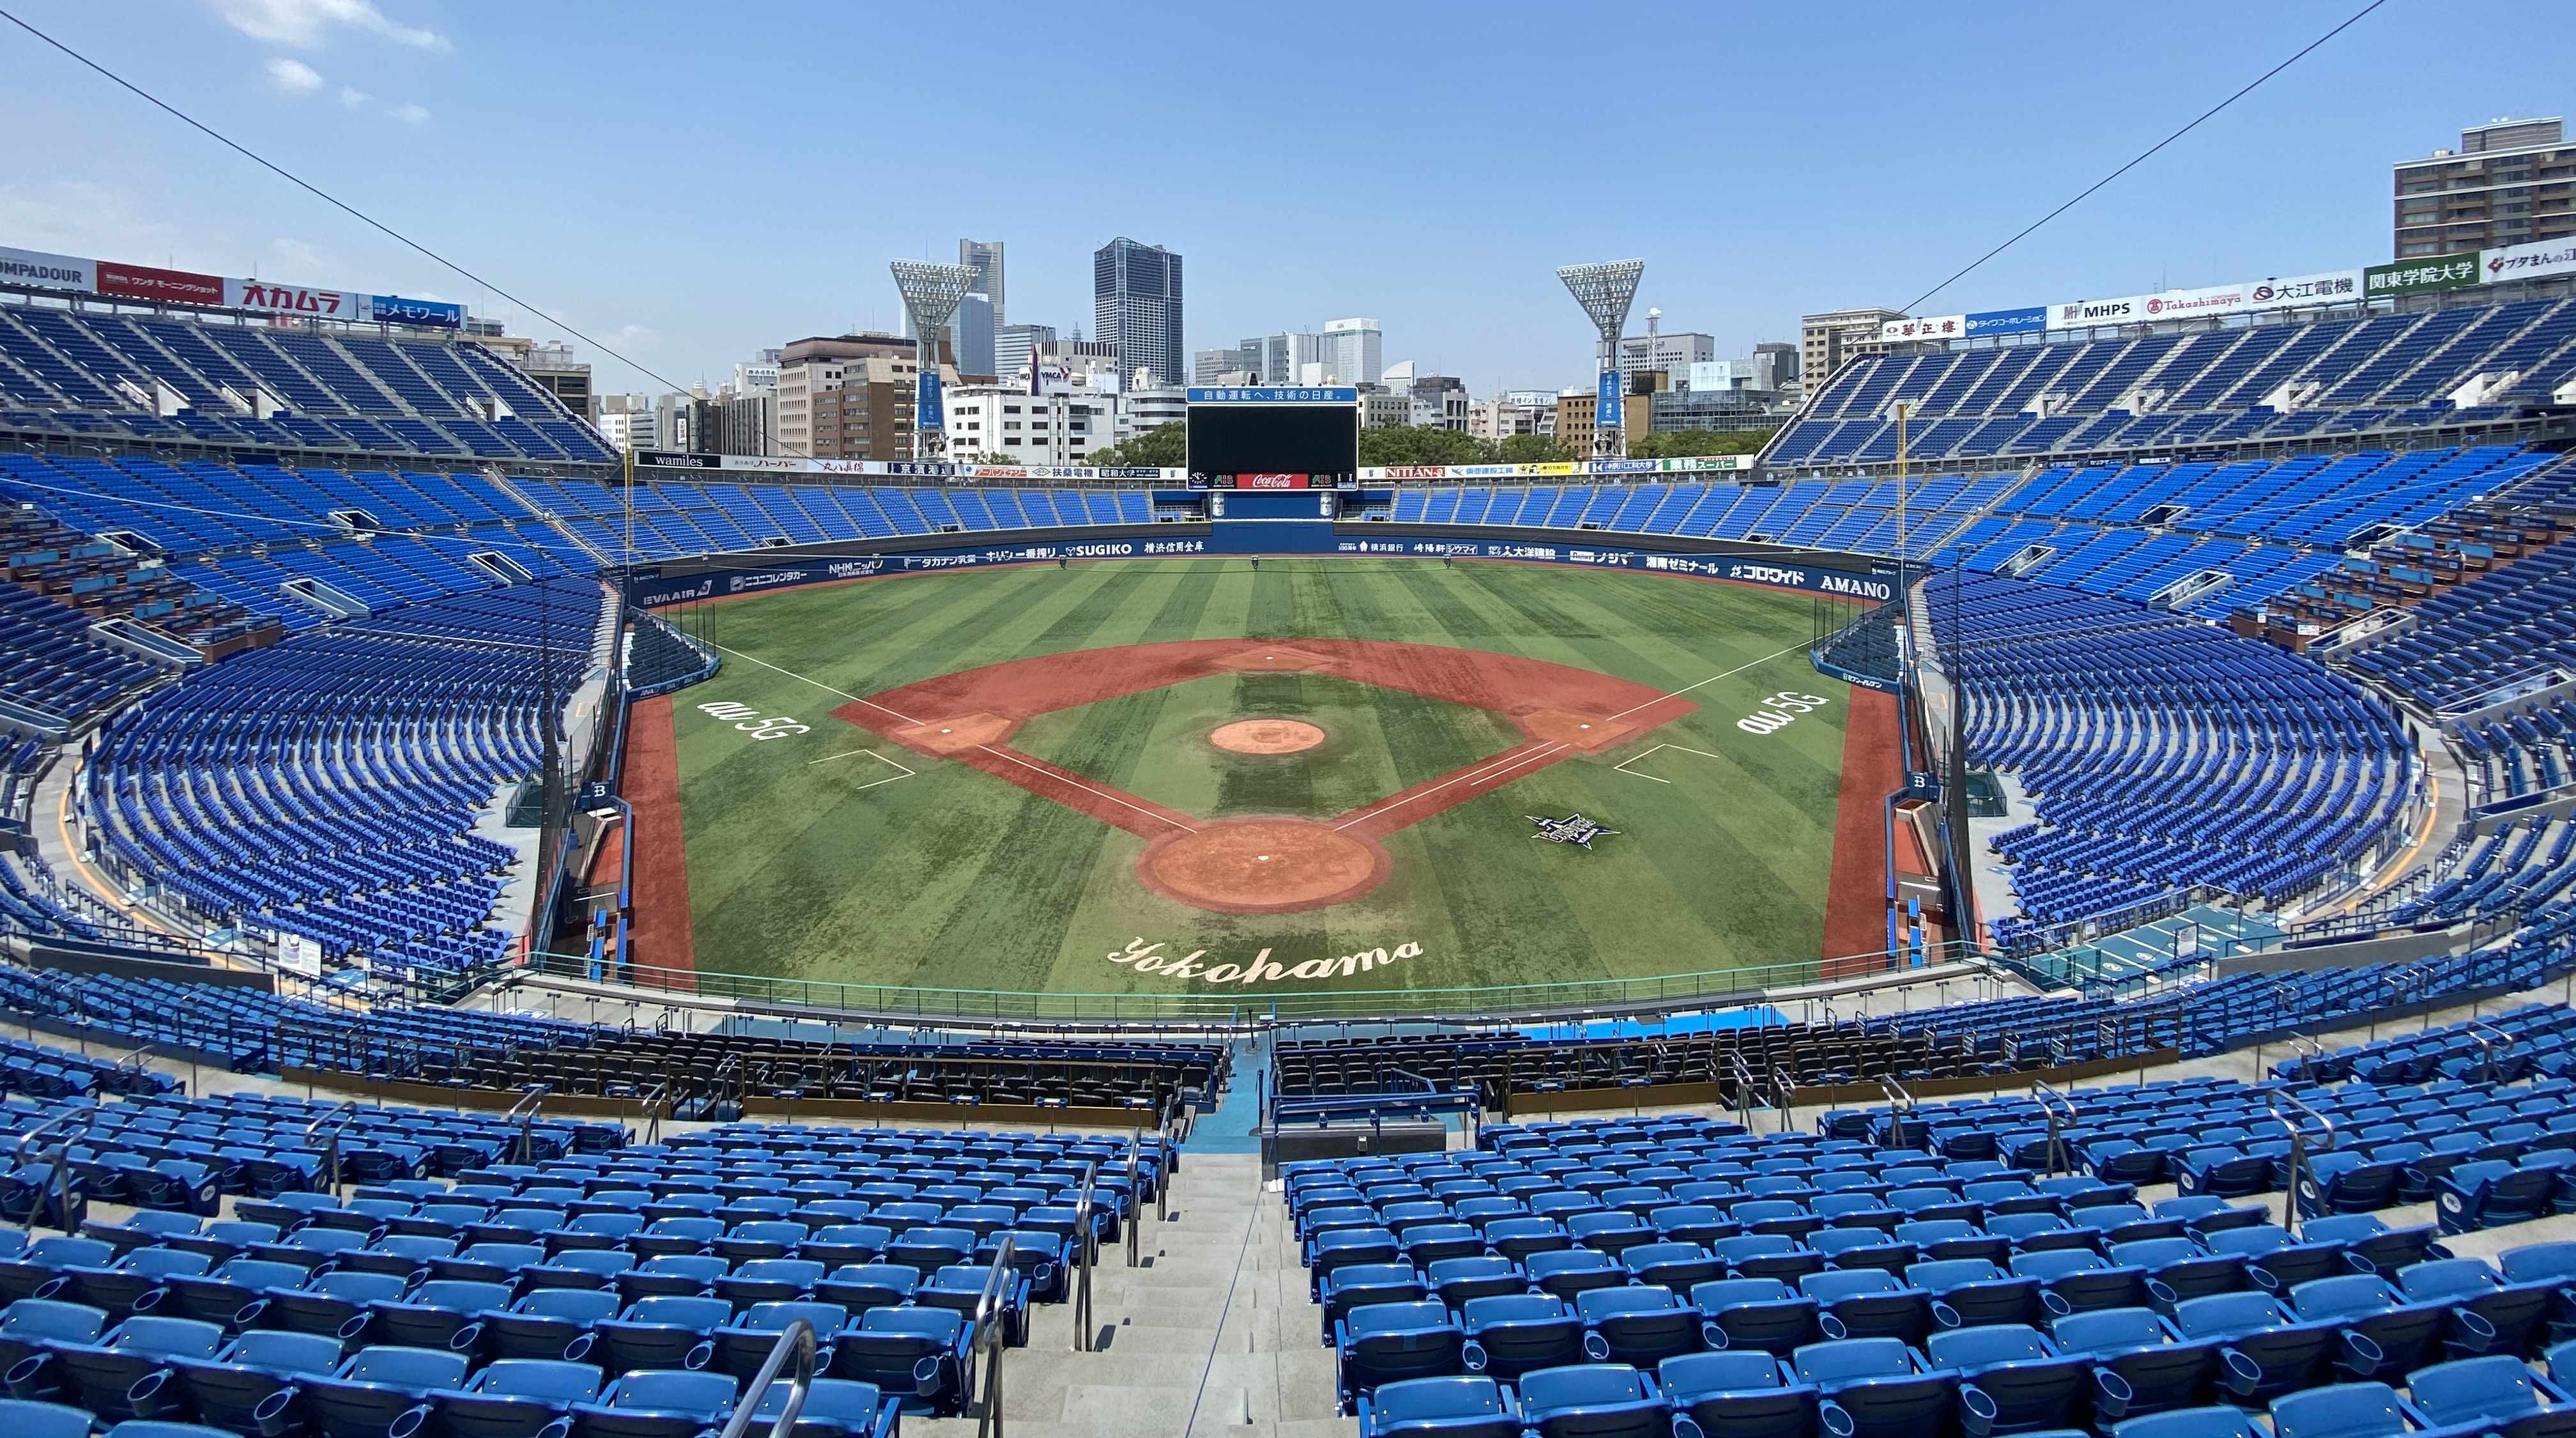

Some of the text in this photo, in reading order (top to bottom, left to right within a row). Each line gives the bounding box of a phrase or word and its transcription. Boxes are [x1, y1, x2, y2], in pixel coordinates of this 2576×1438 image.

[2369, 261, 2473, 290] 関東学院大学
[132, 277, 154, 286] ワンダ
[157, 279, 218, 294] モーニングショット
[2276, 278, 2353, 300] 大江電機
[243, 285, 340, 313] オカムラ
[2165, 297, 2241, 311] Takashimaya
[387, 304, 459, 323] メモワール
[2085, 303, 2130, 318] MHPS
[1978, 314, 2045, 329] ダイワコーポレーション
[1041, 371, 1061, 380] YMCA
[1204, 389, 1341, 401] 自動運転へ、技術の日産。
[655, 454, 703, 467] wamiles
[1670, 459, 1734, 470] 業務スーパー
[1386, 467, 1432, 477] NITTAN
[1253, 474, 1293, 488] Coca-Cola
[1076, 543, 1132, 556] SUGIKO
[1144, 541, 1204, 553] 横浜信用金庫
[1371, 543, 1404, 552] 横浜銀行
[1513, 546, 1556, 560] 大洋建設
[1646, 556, 1719, 575] 湘南ゼミナール
[744, 571, 808, 587] ニコニコレンタカー
[1744, 565, 1804, 585] コロワイド
[1820, 575, 1890, 599] AMANO
[1736, 691, 1830, 735] au 5G
[696, 701, 811, 741] au 5G
[1107, 936, 1423, 984] Yokohama
